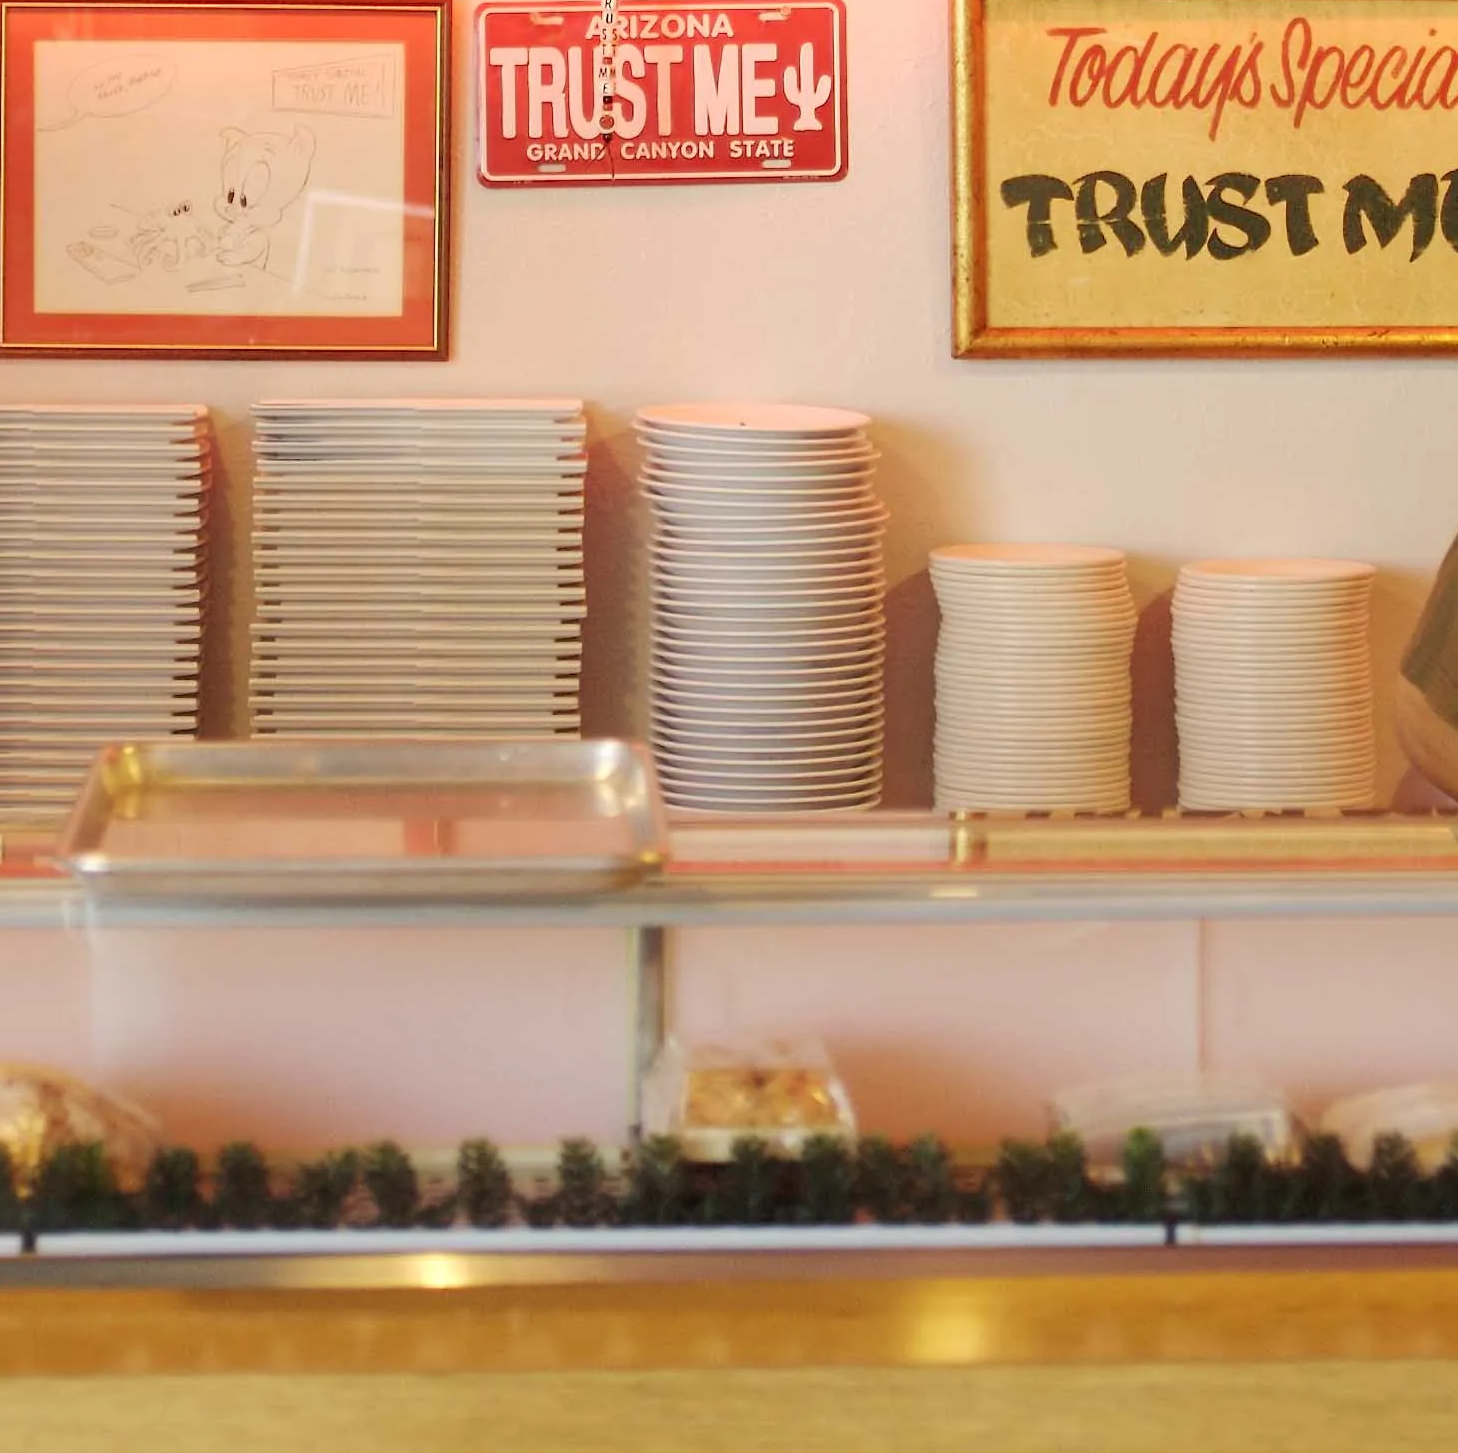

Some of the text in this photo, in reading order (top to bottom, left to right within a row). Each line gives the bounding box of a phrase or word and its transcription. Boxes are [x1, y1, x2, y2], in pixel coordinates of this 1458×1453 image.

[585, 13, 735, 40] ARIZONA
[489, 42, 779, 140] TRUST ME
[1046, 26, 1264, 142] Today's
[526, 140, 795, 162] GRAND CANYON STATE
[1000, 169, 1326, 261] TRUST
